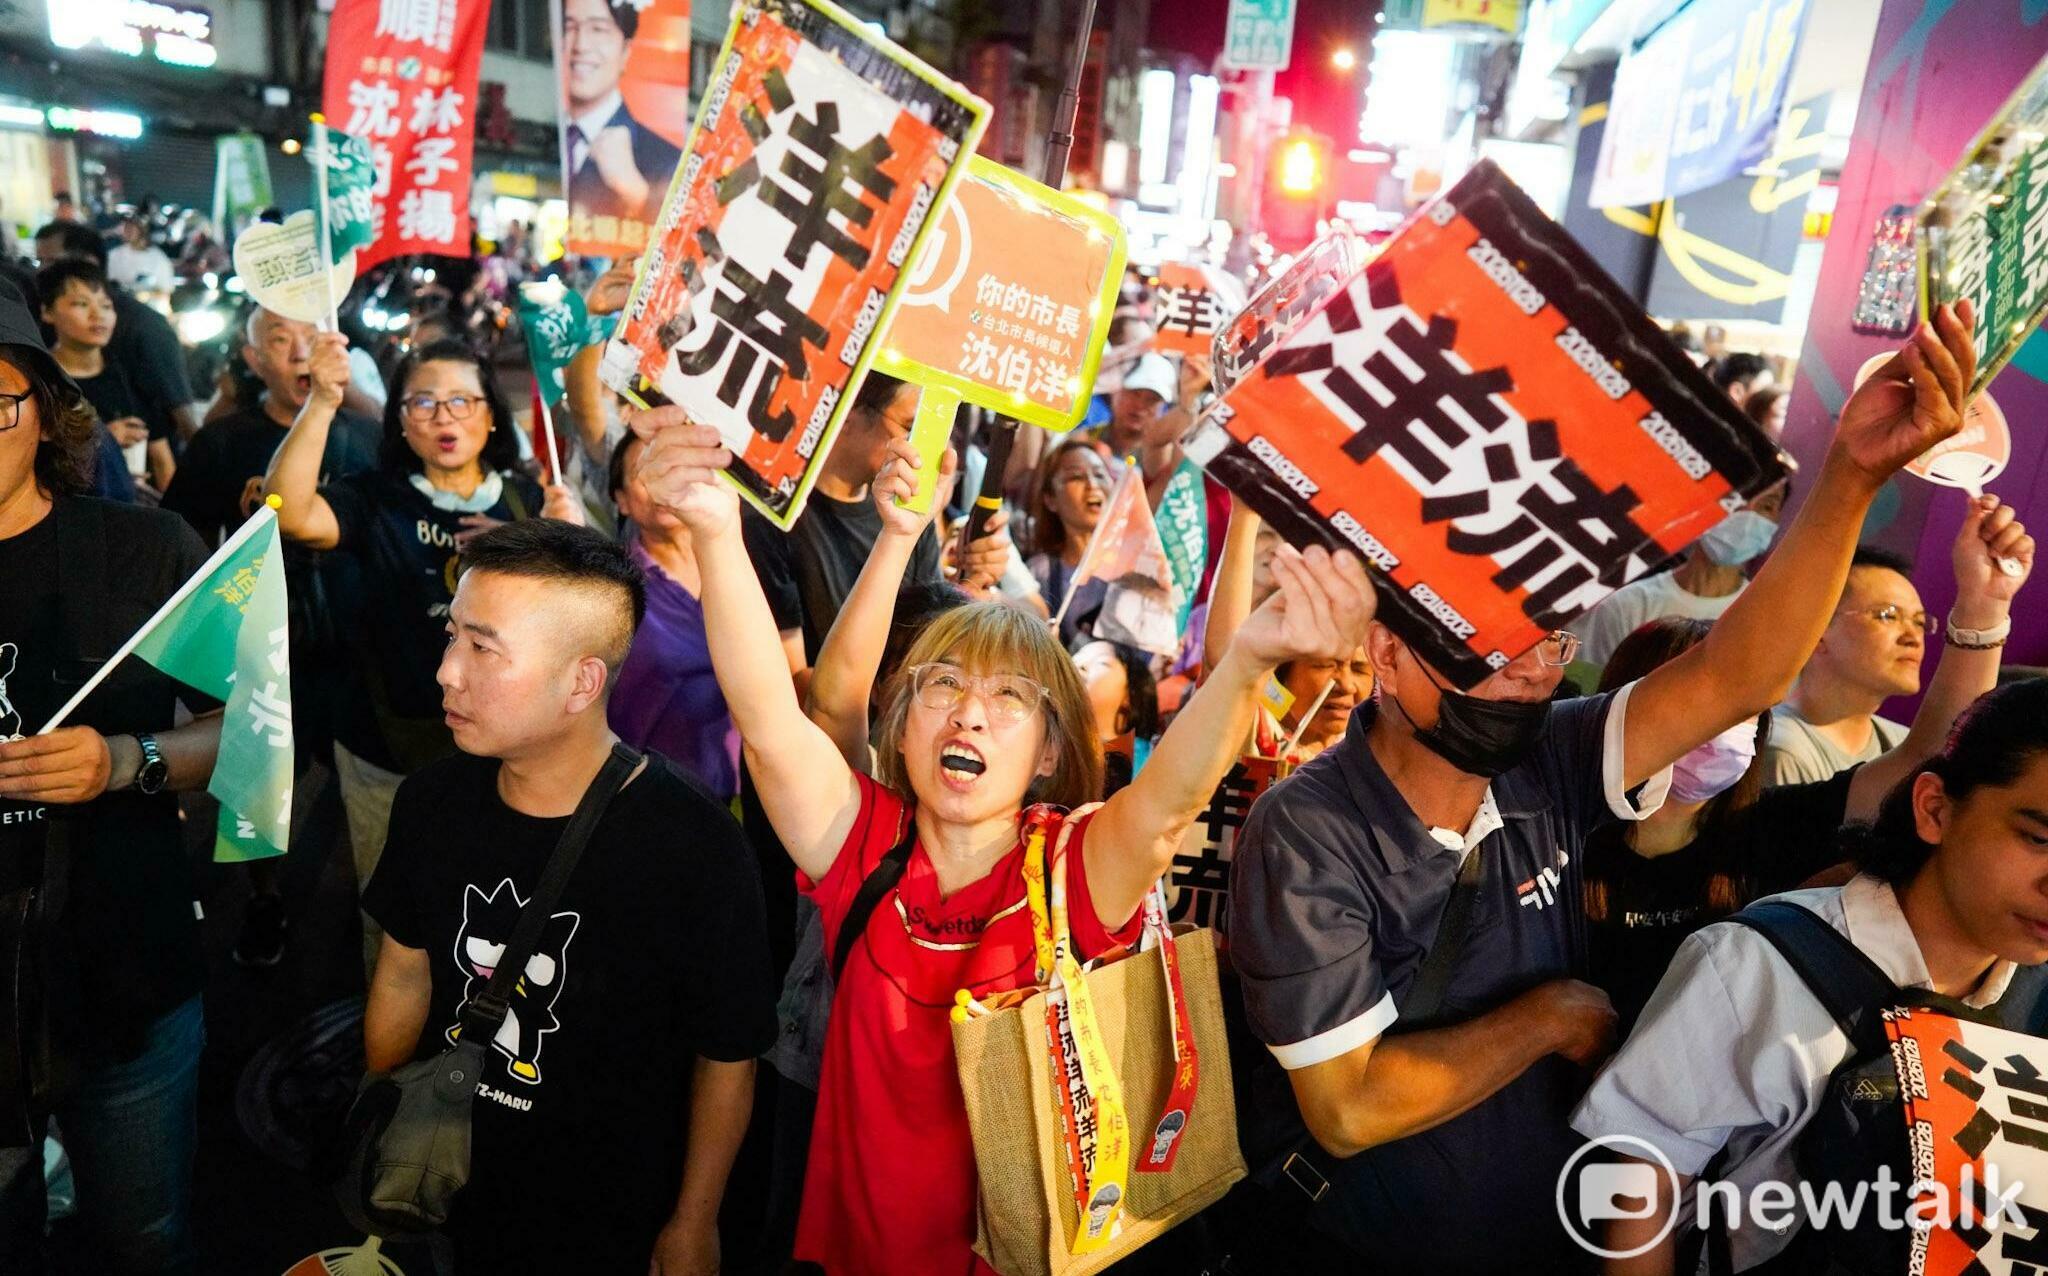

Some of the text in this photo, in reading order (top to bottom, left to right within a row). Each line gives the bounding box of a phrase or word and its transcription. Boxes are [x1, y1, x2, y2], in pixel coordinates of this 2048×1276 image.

[661, 66, 897, 443] 洋流
[887, 182, 936, 267] 20261128
[975, 271, 1081, 340] 你的市長
[1467, 237, 1546, 316] 20261128
[839, 286, 889, 366] 20261128
[982, 313, 1073, 360] 台北市長候選人
[958, 329, 1070, 403] 沈伯洋
[1556, 326, 1631, 400] 20261128
[796, 384, 842, 459] 20261128
[1263, 262, 1660, 635] 洋流
[1639, 411, 1711, 481] 20261128
[1247, 435, 1320, 500] 20261128
[1329, 510, 1400, 572] 20261128
[1409, 582, 1477, 641] 20261128
[1901, 1037, 1929, 1100] 20261128
[1915, 1121, 1935, 1193] 20261128
